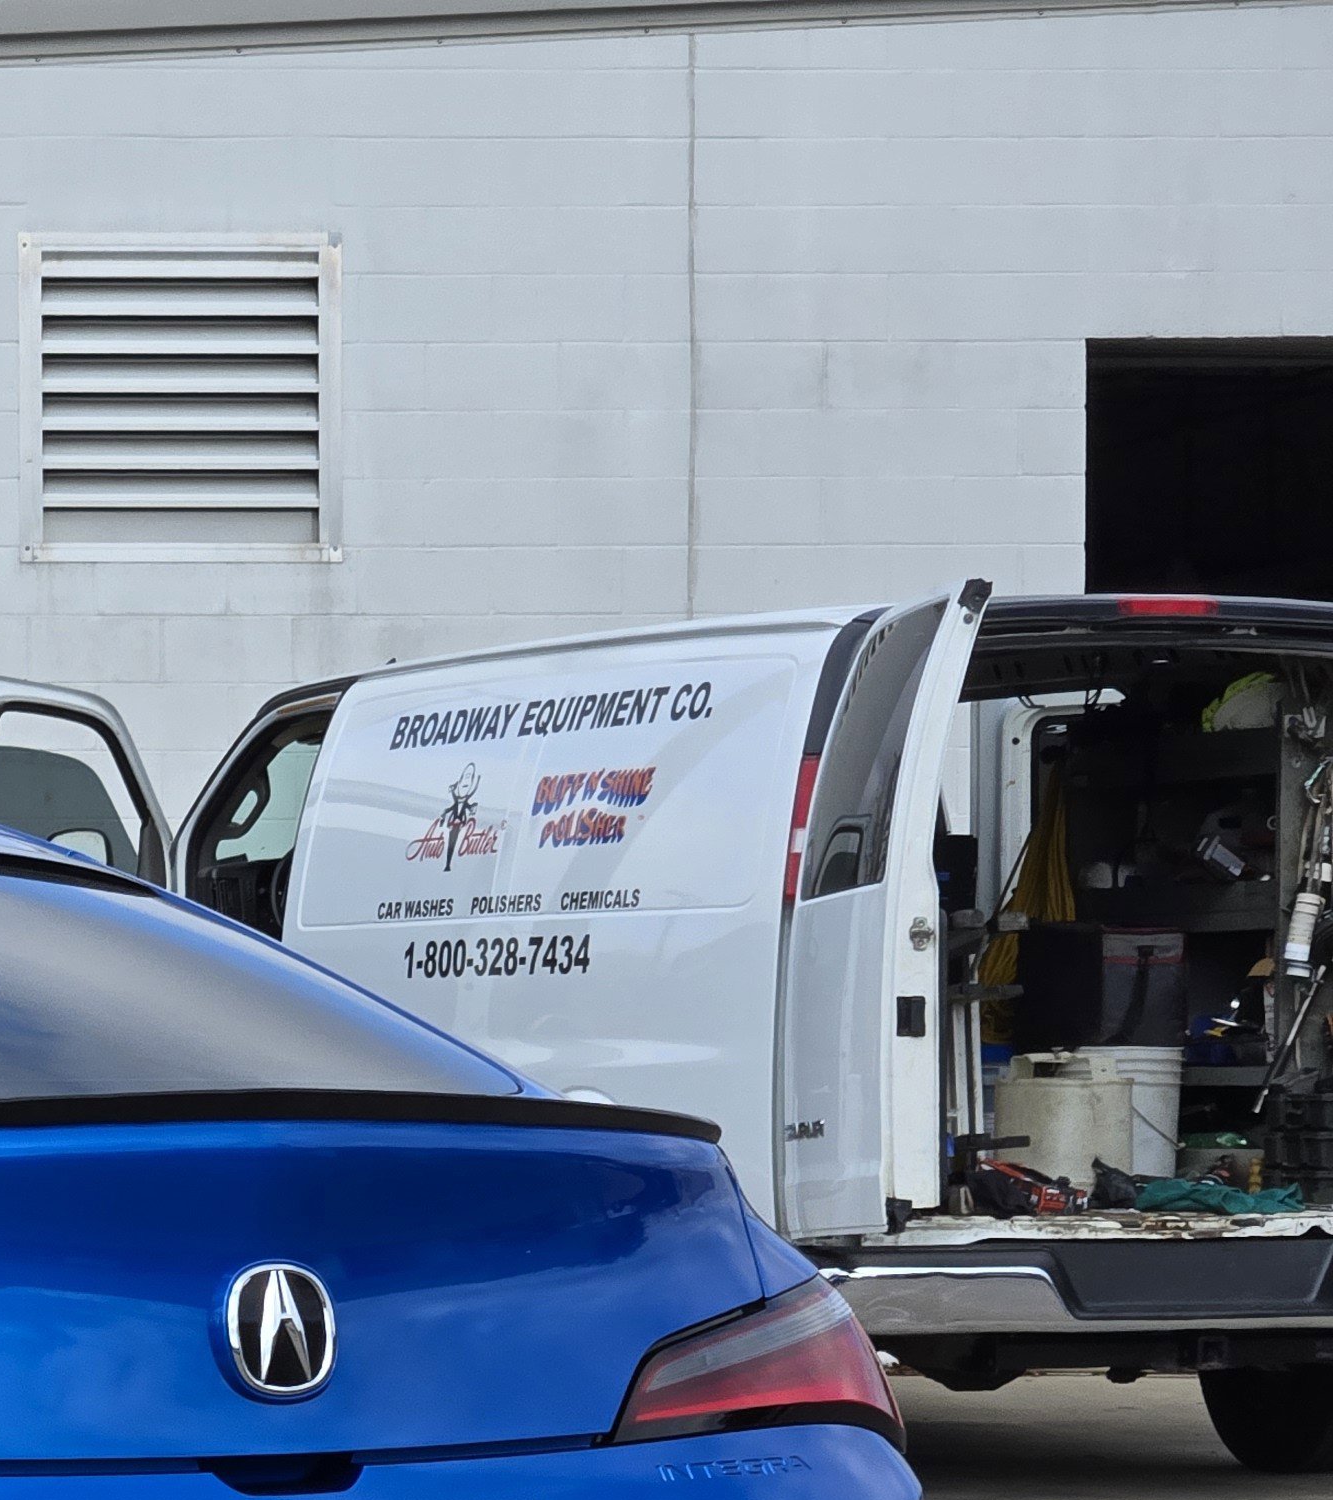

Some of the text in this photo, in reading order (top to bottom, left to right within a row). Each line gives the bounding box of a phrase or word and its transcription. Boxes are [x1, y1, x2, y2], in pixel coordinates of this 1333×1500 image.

[389, 681, 714, 751] BROADWAY EQUIPMENT CO.
[405, 817, 498, 862] Auto Butler
[538, 808, 627, 848] POLISHER
[377, 888, 641, 920] CAR WASHES POLISHERS CHEMICALS
[404, 934, 591, 979] 1-800-328-7434
[655, 1455, 812, 1482] INTEGRA
